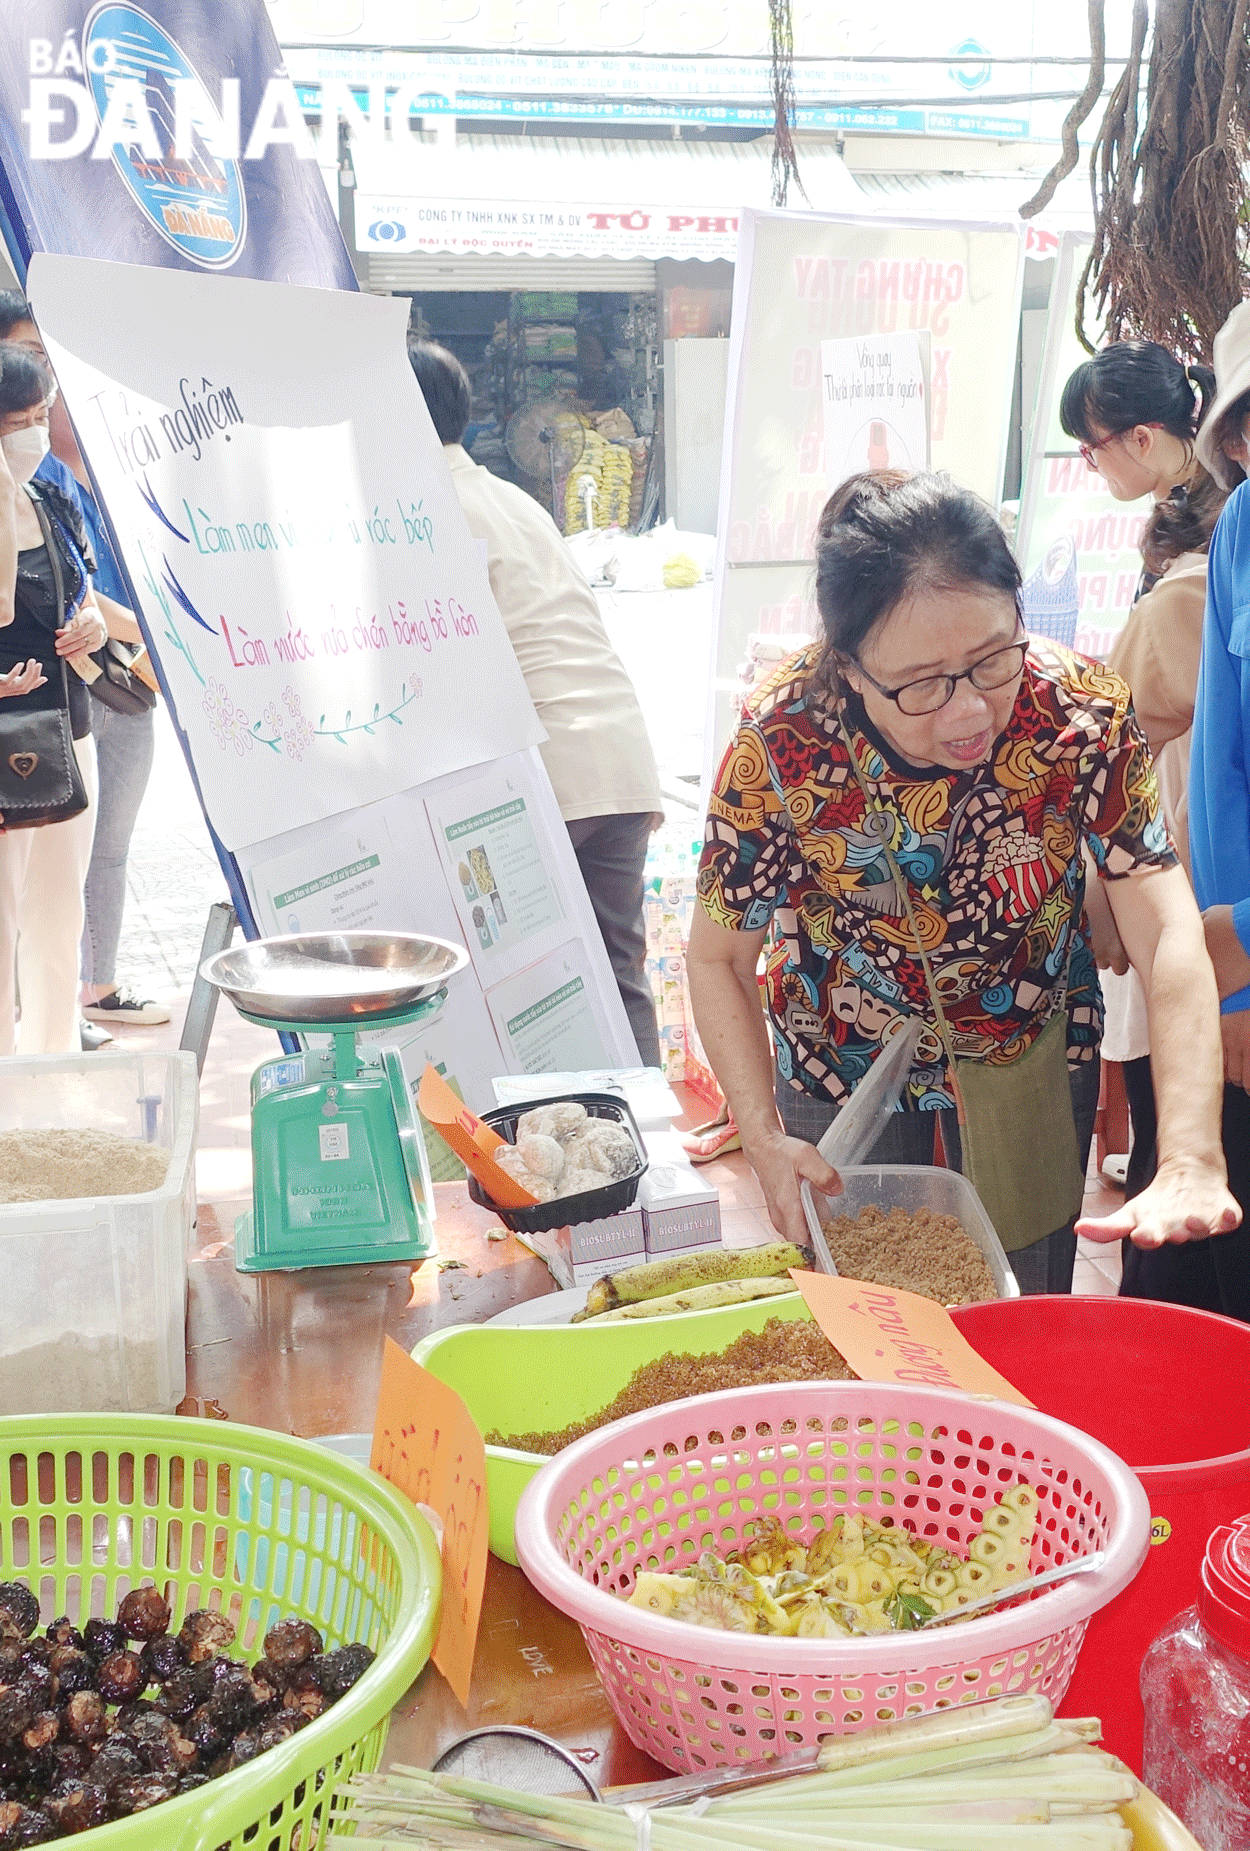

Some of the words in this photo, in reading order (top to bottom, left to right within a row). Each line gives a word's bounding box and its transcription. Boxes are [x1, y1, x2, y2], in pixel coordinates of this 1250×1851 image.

[418, 207, 447, 222] CÔNG
[451, 210, 463, 222] TY
[466, 211, 493, 223] TNHH
[497, 212, 518, 224] XNK
[522, 213, 535, 225] SX
[539, 214, 553, 225] TM
[558, 214, 564, 226] &
[569, 215, 581, 226] DV
[86, 390, 161, 475] Trải
[159, 377, 244, 461] nghiệm
[182, 498, 237, 554] Làm
[236, 521, 279, 551] men
[366, 505, 397, 544] rác
[397, 498, 434, 554] bếp
[220, 615, 270, 667] Làm
[274, 611, 315, 663] nước
[353, 607, 389, 650] chén
[389, 601, 432, 653] bằng
[425, 599, 448, 639] bồ
[449, 597, 480, 637] hòn
[580, 1228, 636, 1248] BIOSUBTYL-II
[659, 1217, 714, 1237] BIOSUBTYL-II
